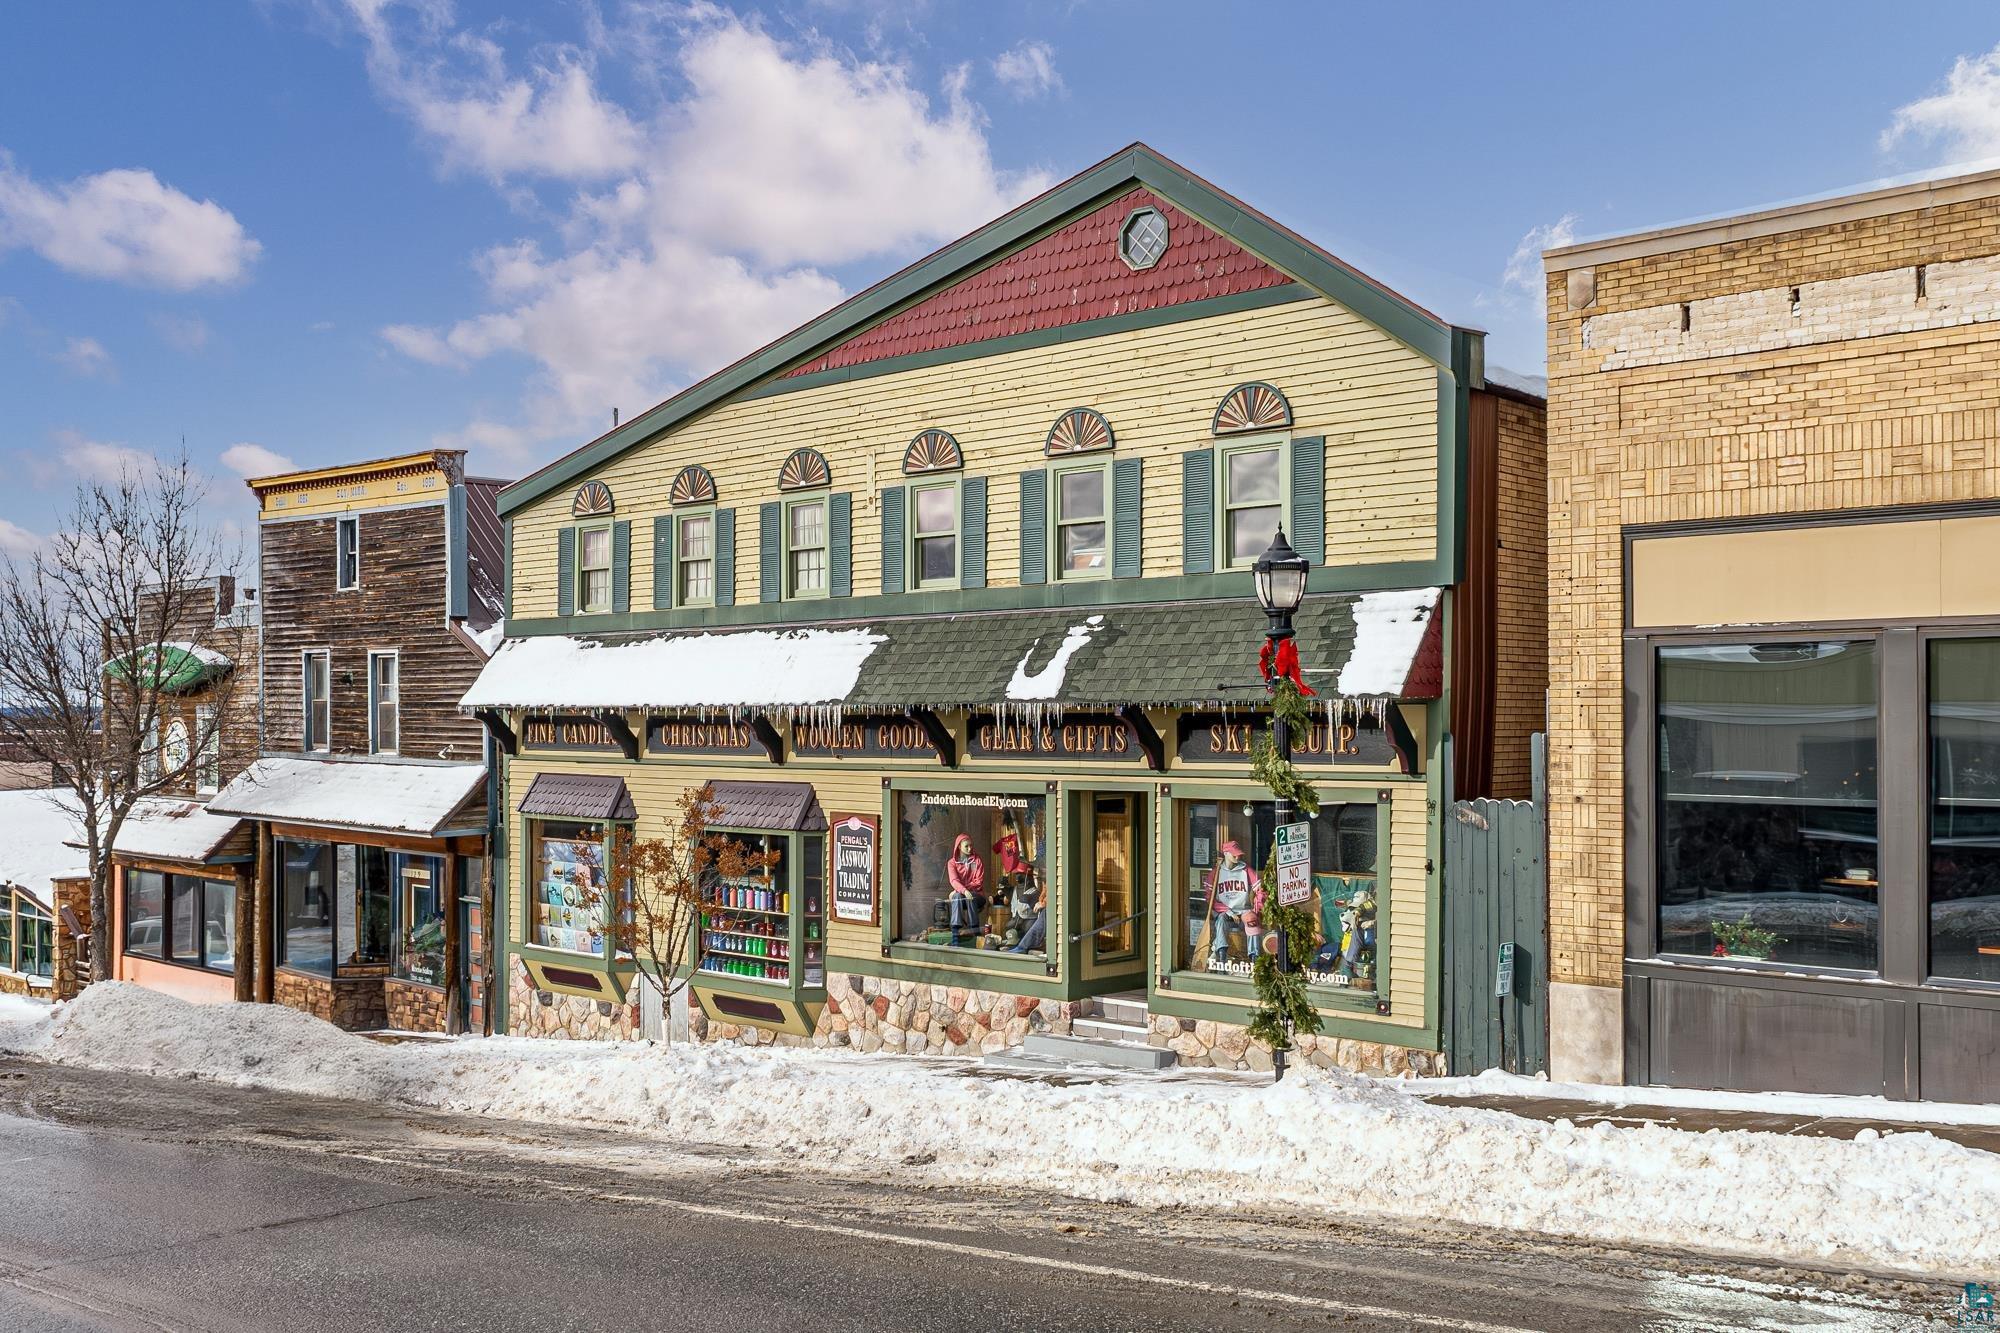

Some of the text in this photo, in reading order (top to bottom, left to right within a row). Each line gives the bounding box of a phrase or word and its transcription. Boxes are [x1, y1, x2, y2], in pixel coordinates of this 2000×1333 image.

[527, 722, 617, 745] FINE CANDIE
[662, 723, 751, 749] CHRISTMAS
[795, 724, 936, 750] WOOLEN GOOD
[980, 725, 1129, 753] GEAR & GIFTS
[1210, 724, 1254, 754] SKI
[920, 793, 1028, 809] EndoftheRoadEly.com
[840, 835, 868, 846] PENGAL'S
[1280, 829, 1286, 844] 2
[1289, 832, 1307, 841] PARKING
[1285, 845, 1292, 853] AM
[1301, 842, 1307, 850] PM
[837, 841, 872, 873] BASSWOOD
[1289, 866, 1299, 879] NO
[838, 871, 870, 890] TRADING
[1218, 880, 1247, 895] BWCA
[1282, 878, 1307, 893] PARKING
[838, 891, 870, 900] COMPANY
[1286, 892, 1293, 901] AM
[1301, 889, 1308, 897] AM
